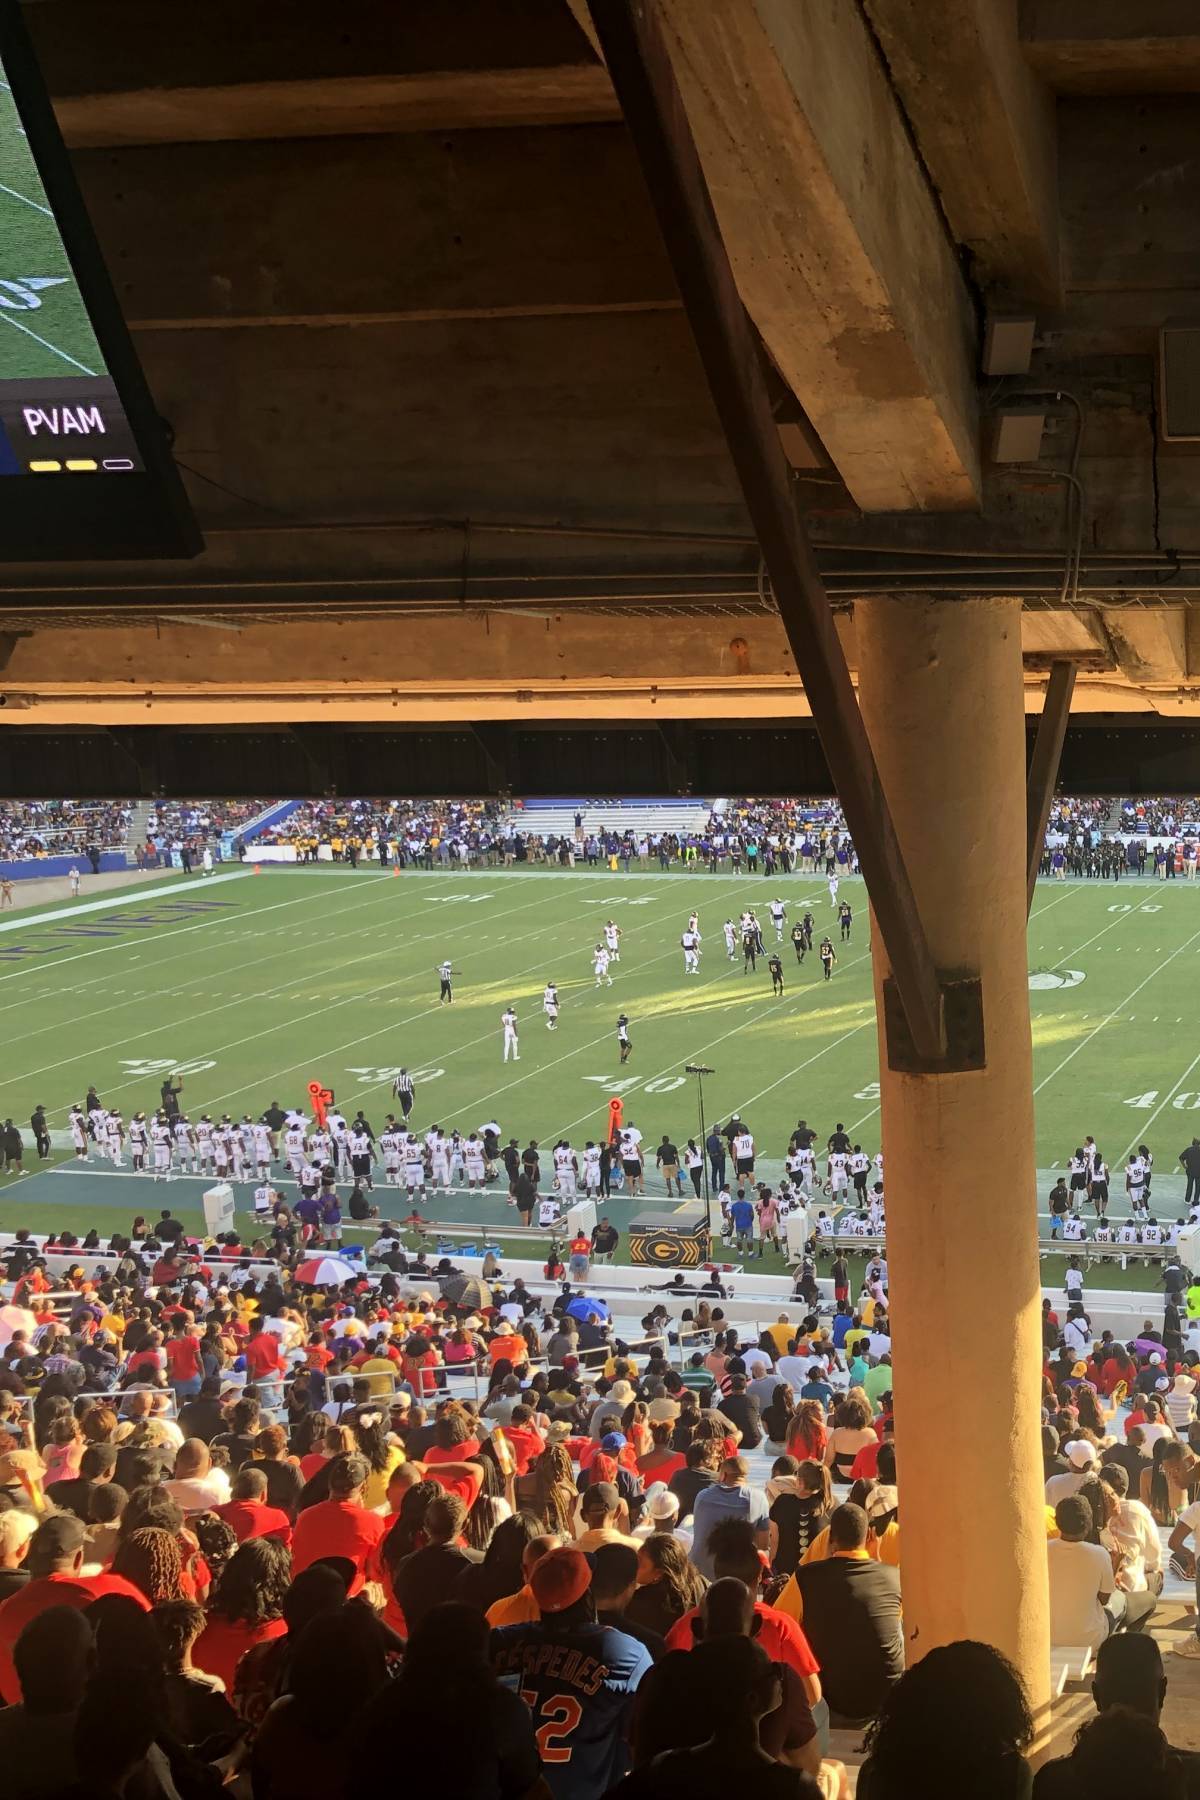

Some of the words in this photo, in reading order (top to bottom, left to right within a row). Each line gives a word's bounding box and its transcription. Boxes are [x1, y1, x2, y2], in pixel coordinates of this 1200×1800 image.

[23, 406, 106, 436] PVAM
[122, 1058, 217, 1076] 20
[599, 1075, 687, 1093] 40
[853, 1082, 881, 1100] 5
[406, 1149, 416, 1158] 65
[1146, 1230, 1157, 1240] 92
